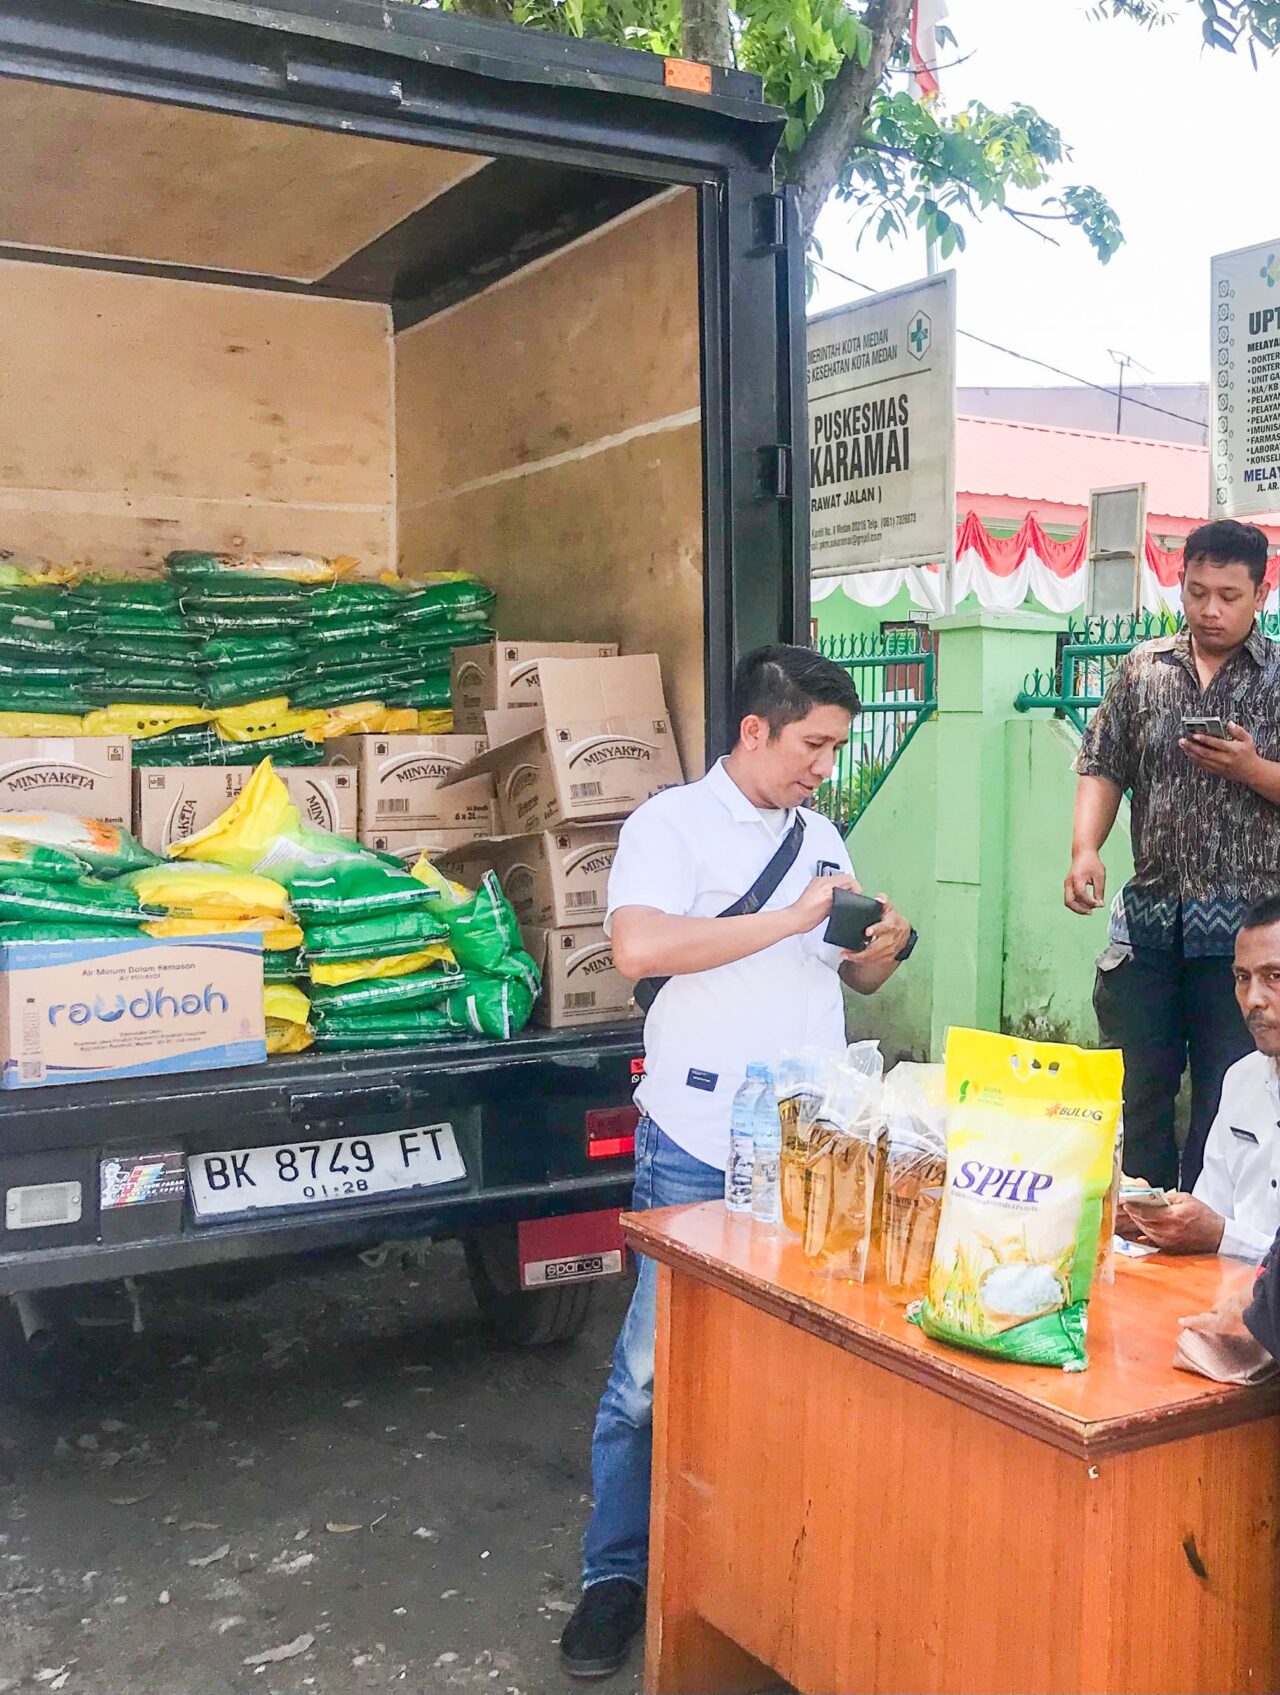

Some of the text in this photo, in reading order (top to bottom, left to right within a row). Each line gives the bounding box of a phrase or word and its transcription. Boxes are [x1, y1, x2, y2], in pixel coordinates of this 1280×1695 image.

[808, 328, 889, 365] MERINTAH KOTA MEDAN
[812, 357, 850, 382] KESEHATAN
[852, 353, 871, 371] KOTA
[872, 344, 898, 367] MEDAN
[1251, 351, 1280, 365] DOKTER
[1251, 361, 1280, 375] DOKTER
[1251, 373, 1269, 385] UNIT
[1251, 382, 1279, 394] KIA/KB
[814, 393, 909, 445] PUSKESMAS
[810, 426, 909, 488] KARAMAI
[1256, 483, 1266, 492] JL.
[1267, 481, 1280, 491] AR.
[811, 493, 842, 512] RAWAT
[843, 486, 875, 506] JALAN
[582, 746, 651, 767] MINYAKITA
[7, 772, 95, 792] MINYAKITA
[396, 763, 450, 784] MINYAK
[177, 799, 198, 840] AKITA
[305, 794, 326, 829] MINY
[580, 854, 614, 876] MINY
[82, 962, 196, 977] Air Minum Dalam Kemasan
[581, 956, 616, 976] MINY
[48, 982, 229, 1028] raudhah
[1059, 1107, 1104, 1122] BULOG
[204, 1152, 257, 1191] BK
[275, 1140, 375, 1182] 8749
[399, 1127, 443, 1168] FT
[952, 1160, 1054, 1204] SPHP
[546, 1257, 602, 1280] sparco
